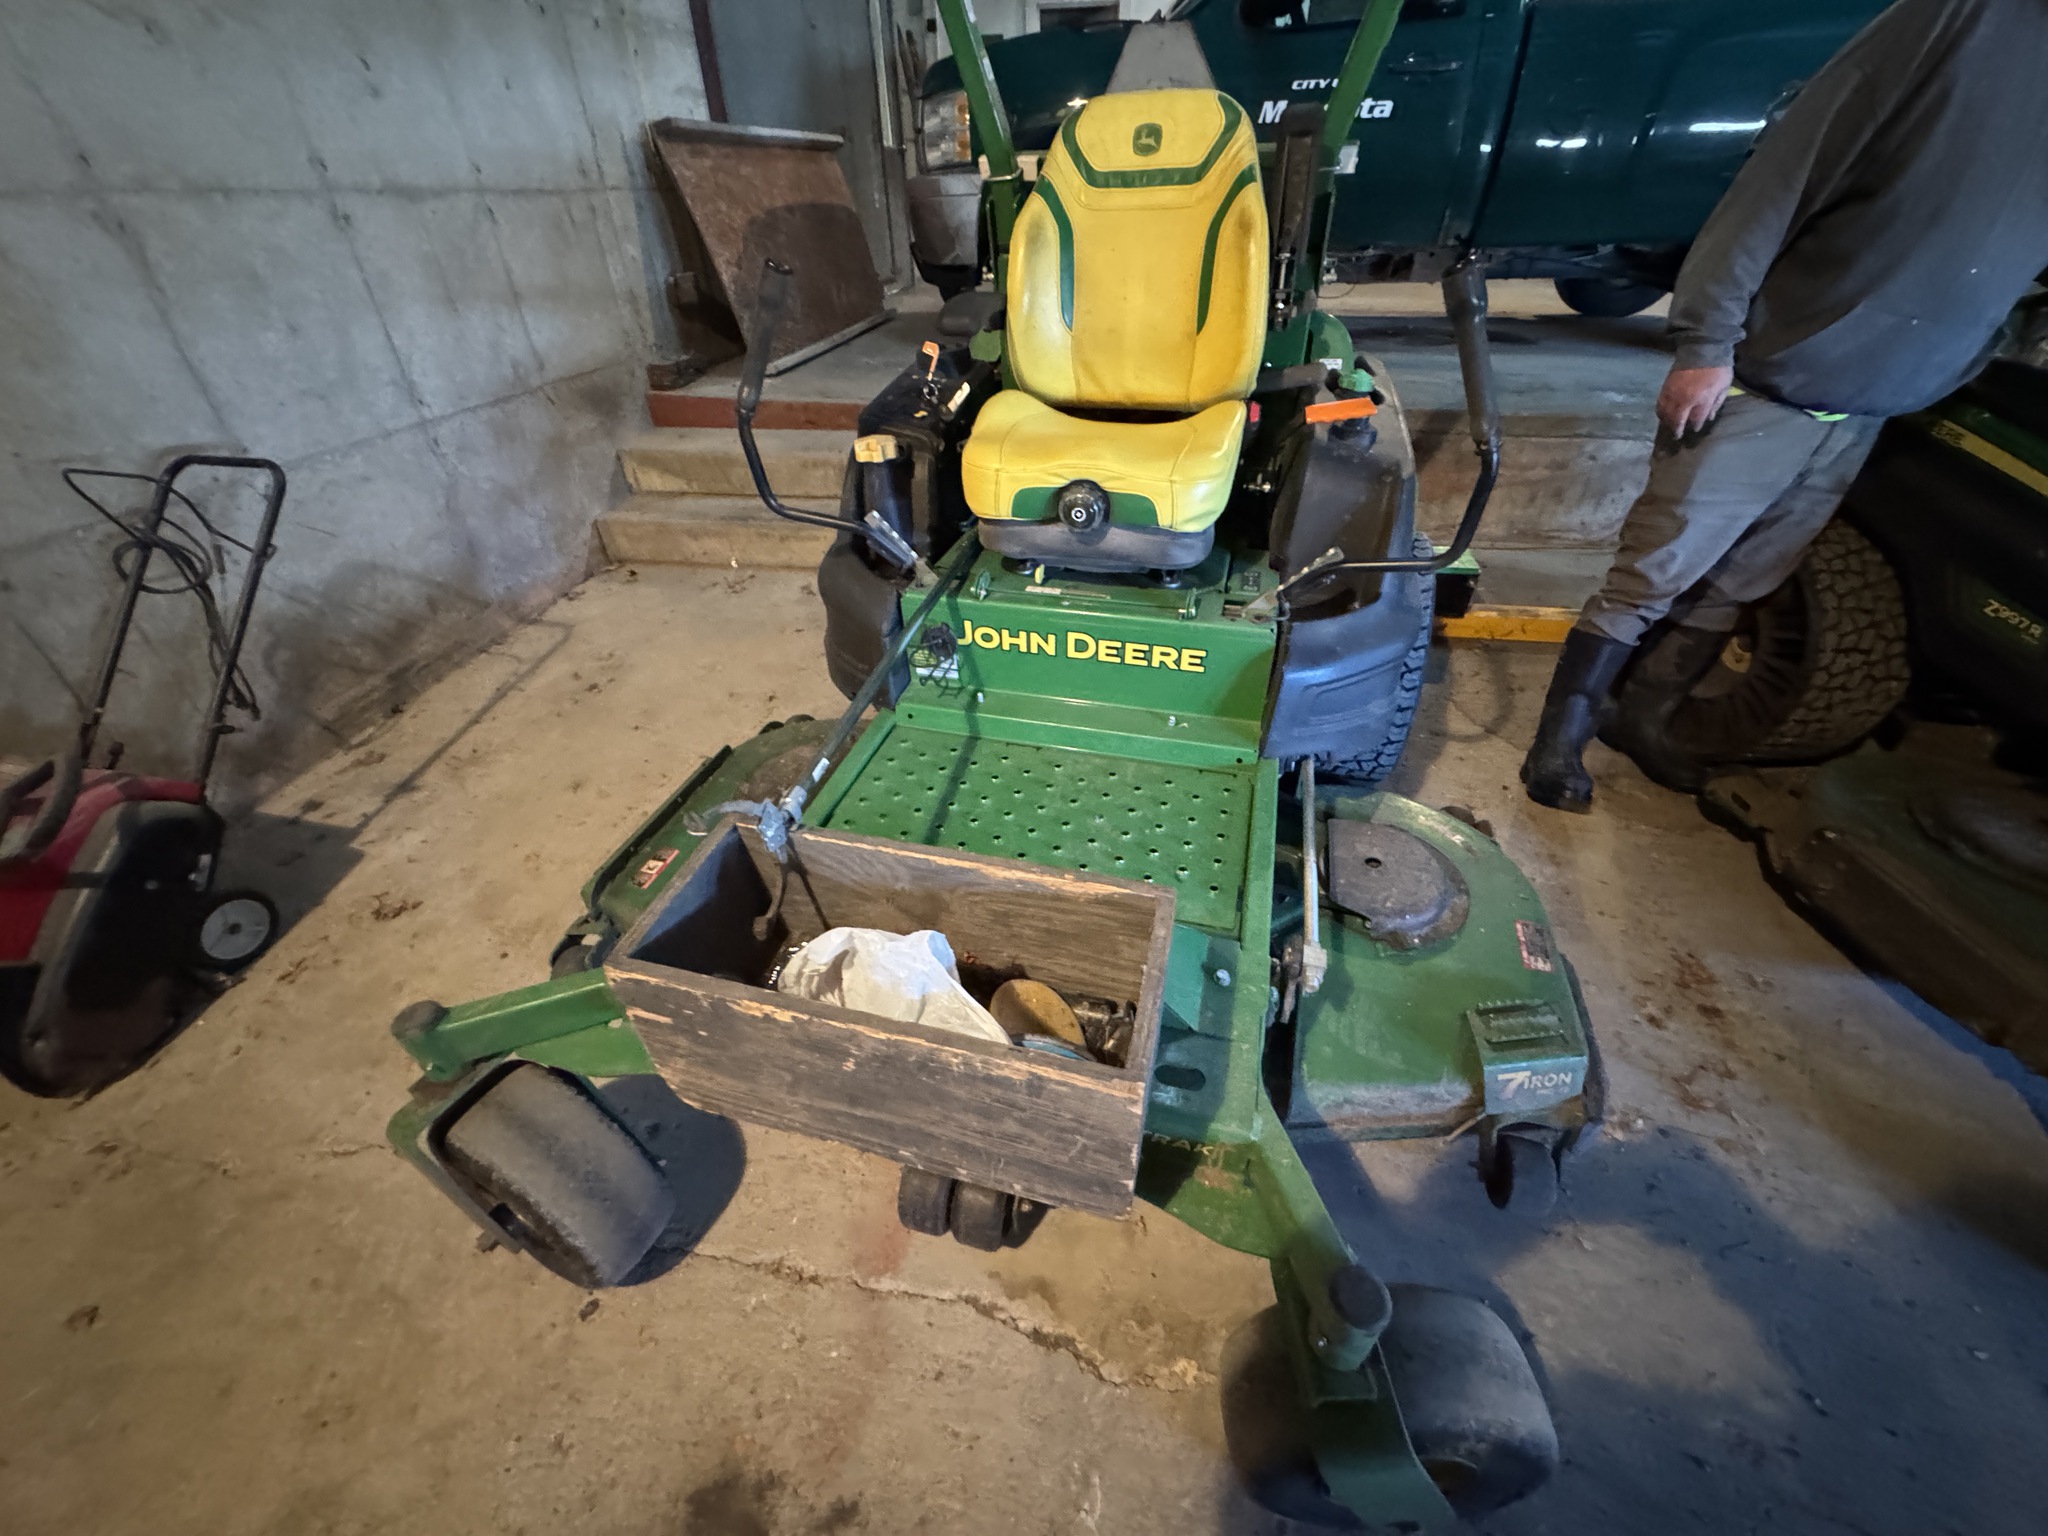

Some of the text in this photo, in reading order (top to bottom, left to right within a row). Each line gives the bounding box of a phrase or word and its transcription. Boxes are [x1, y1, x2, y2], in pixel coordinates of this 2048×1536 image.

[1291, 78, 1331, 90] CITY
[957, 619, 1208, 674] JOHN DEERE
